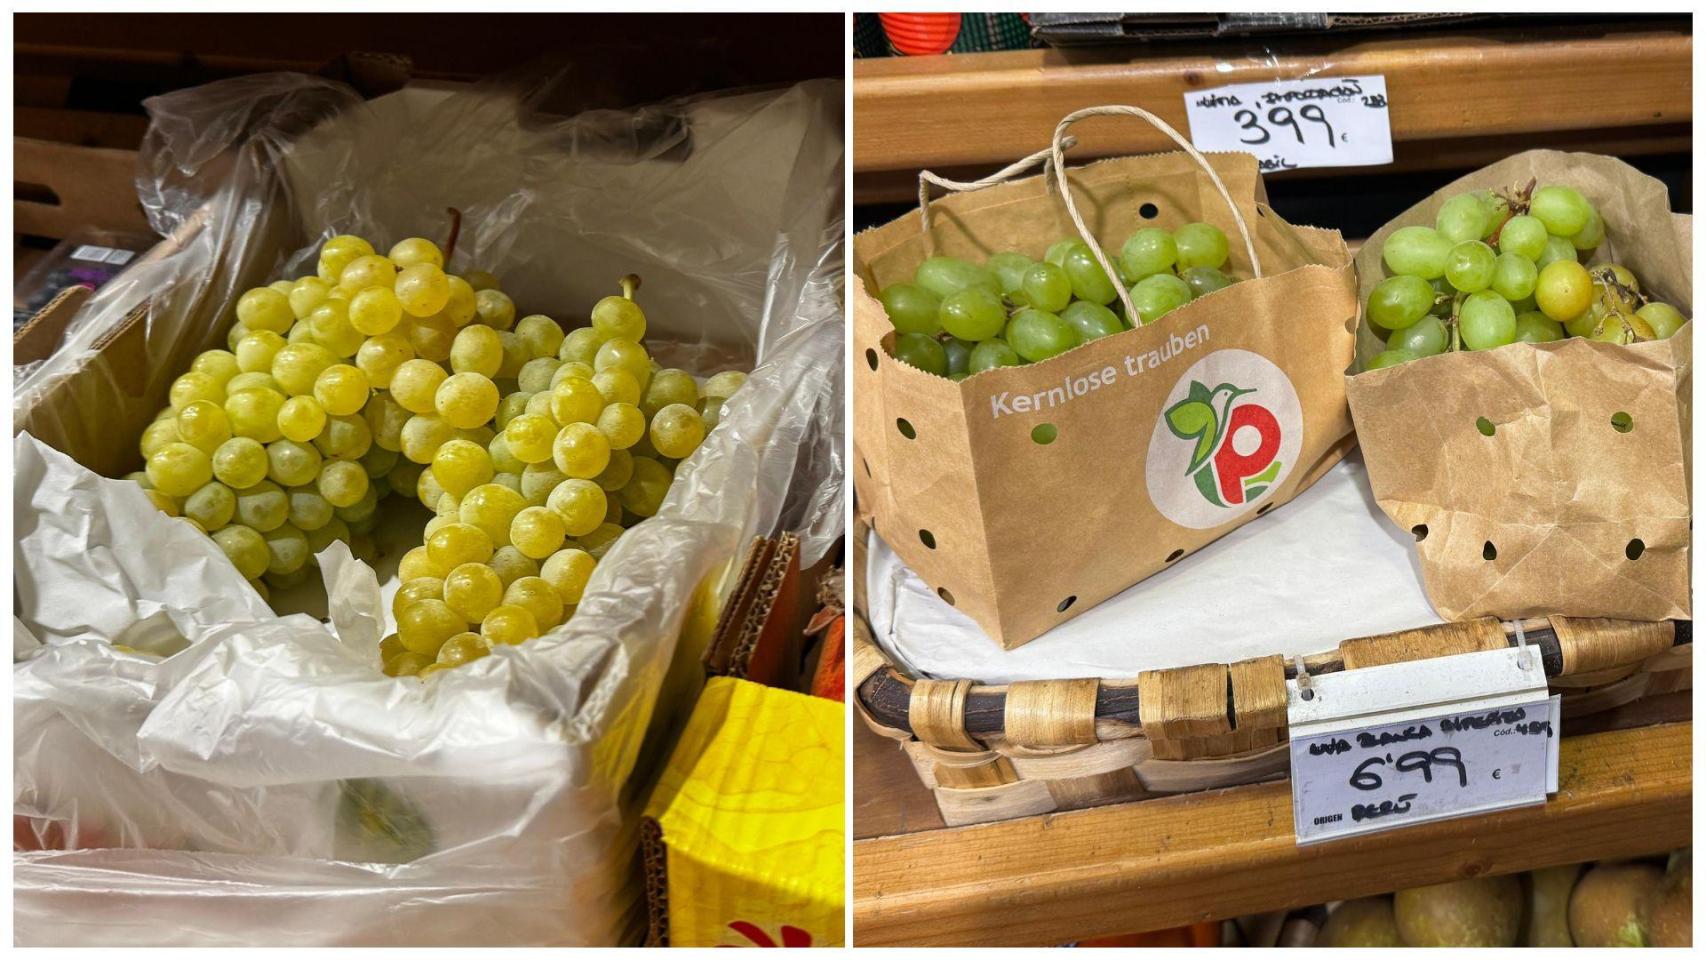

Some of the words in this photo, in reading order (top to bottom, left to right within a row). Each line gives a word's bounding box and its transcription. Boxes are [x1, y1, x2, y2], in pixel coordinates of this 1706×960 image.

[1341, 132, 1348, 143] €
[991, 364, 1118, 420] Kernlose
[1124, 323, 1210, 377] trauben
[1491, 768, 1501, 780] €
[1313, 813, 1343, 826] ORIGEN
